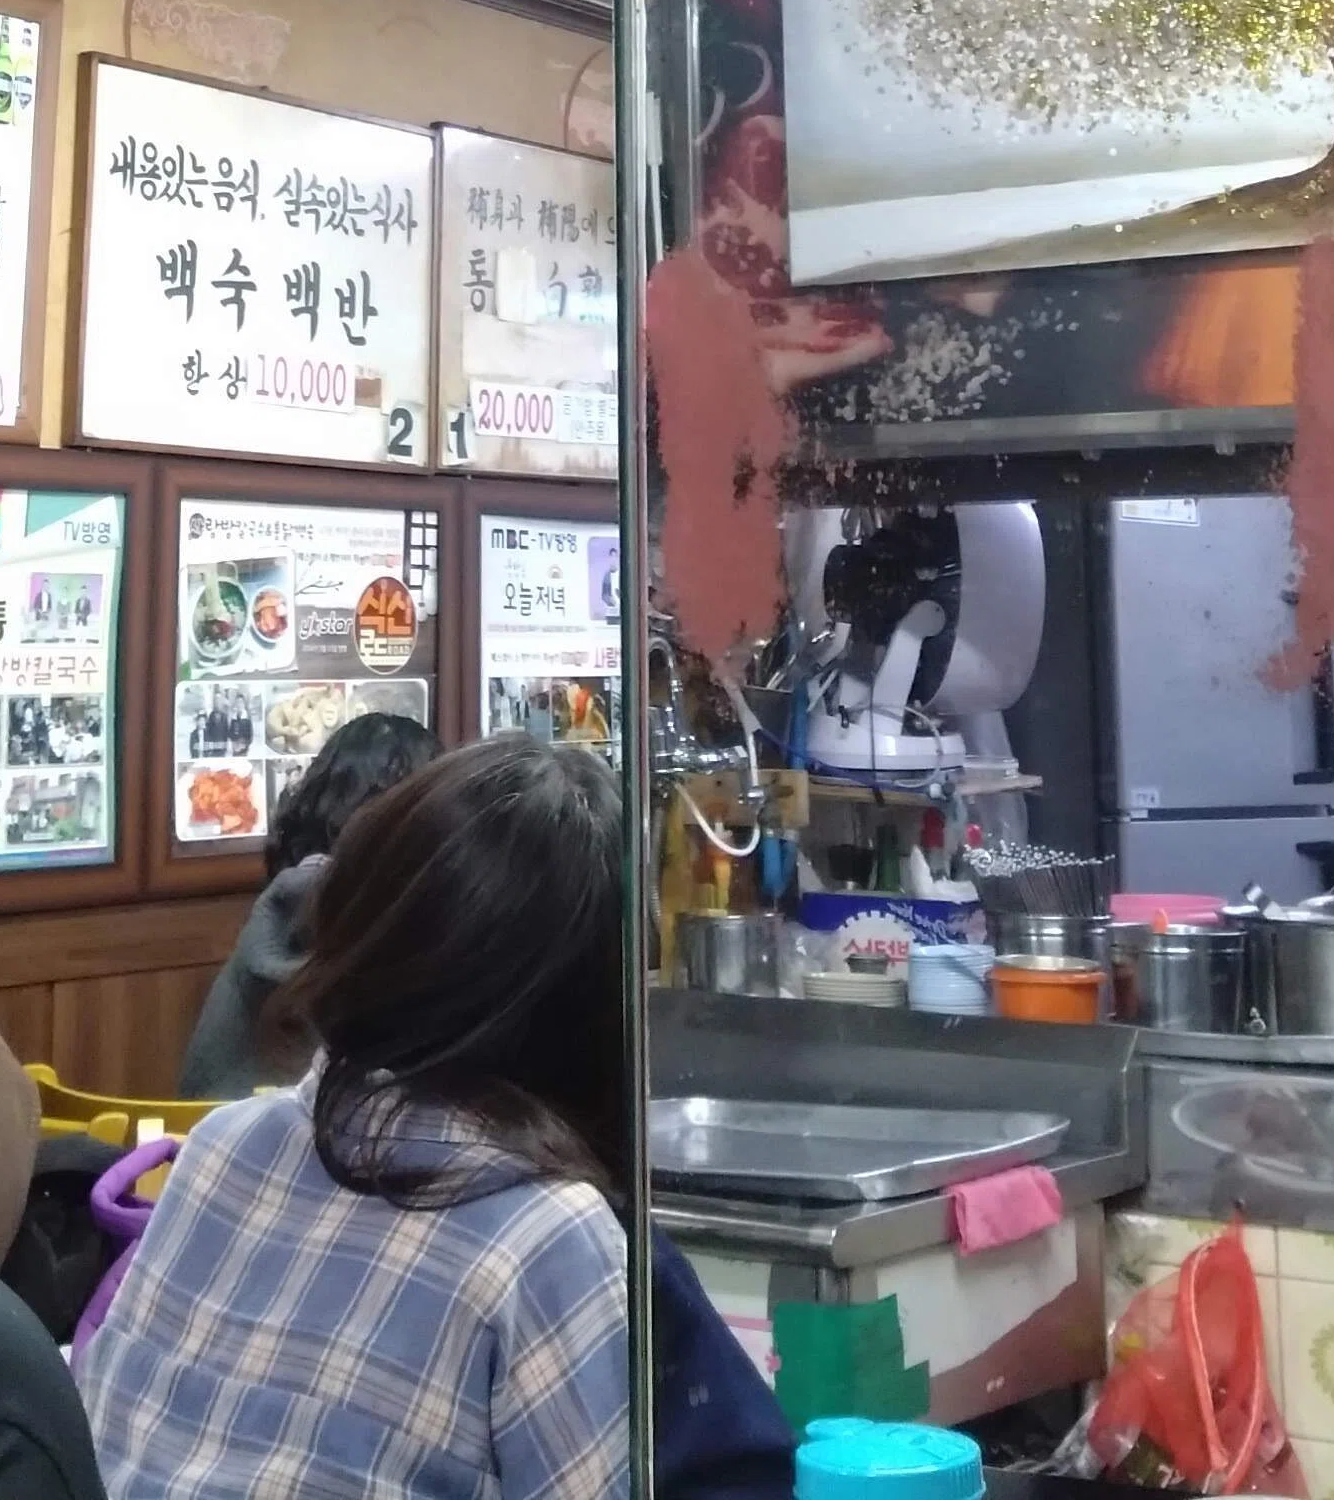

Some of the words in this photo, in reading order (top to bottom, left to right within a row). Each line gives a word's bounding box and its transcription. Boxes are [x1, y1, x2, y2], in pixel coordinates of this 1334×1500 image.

[255, 355, 347, 405] 10,000
[388, 408, 413, 457] 2
[450, 411, 468, 458] 1
[477, 389, 554, 434] 20,000
